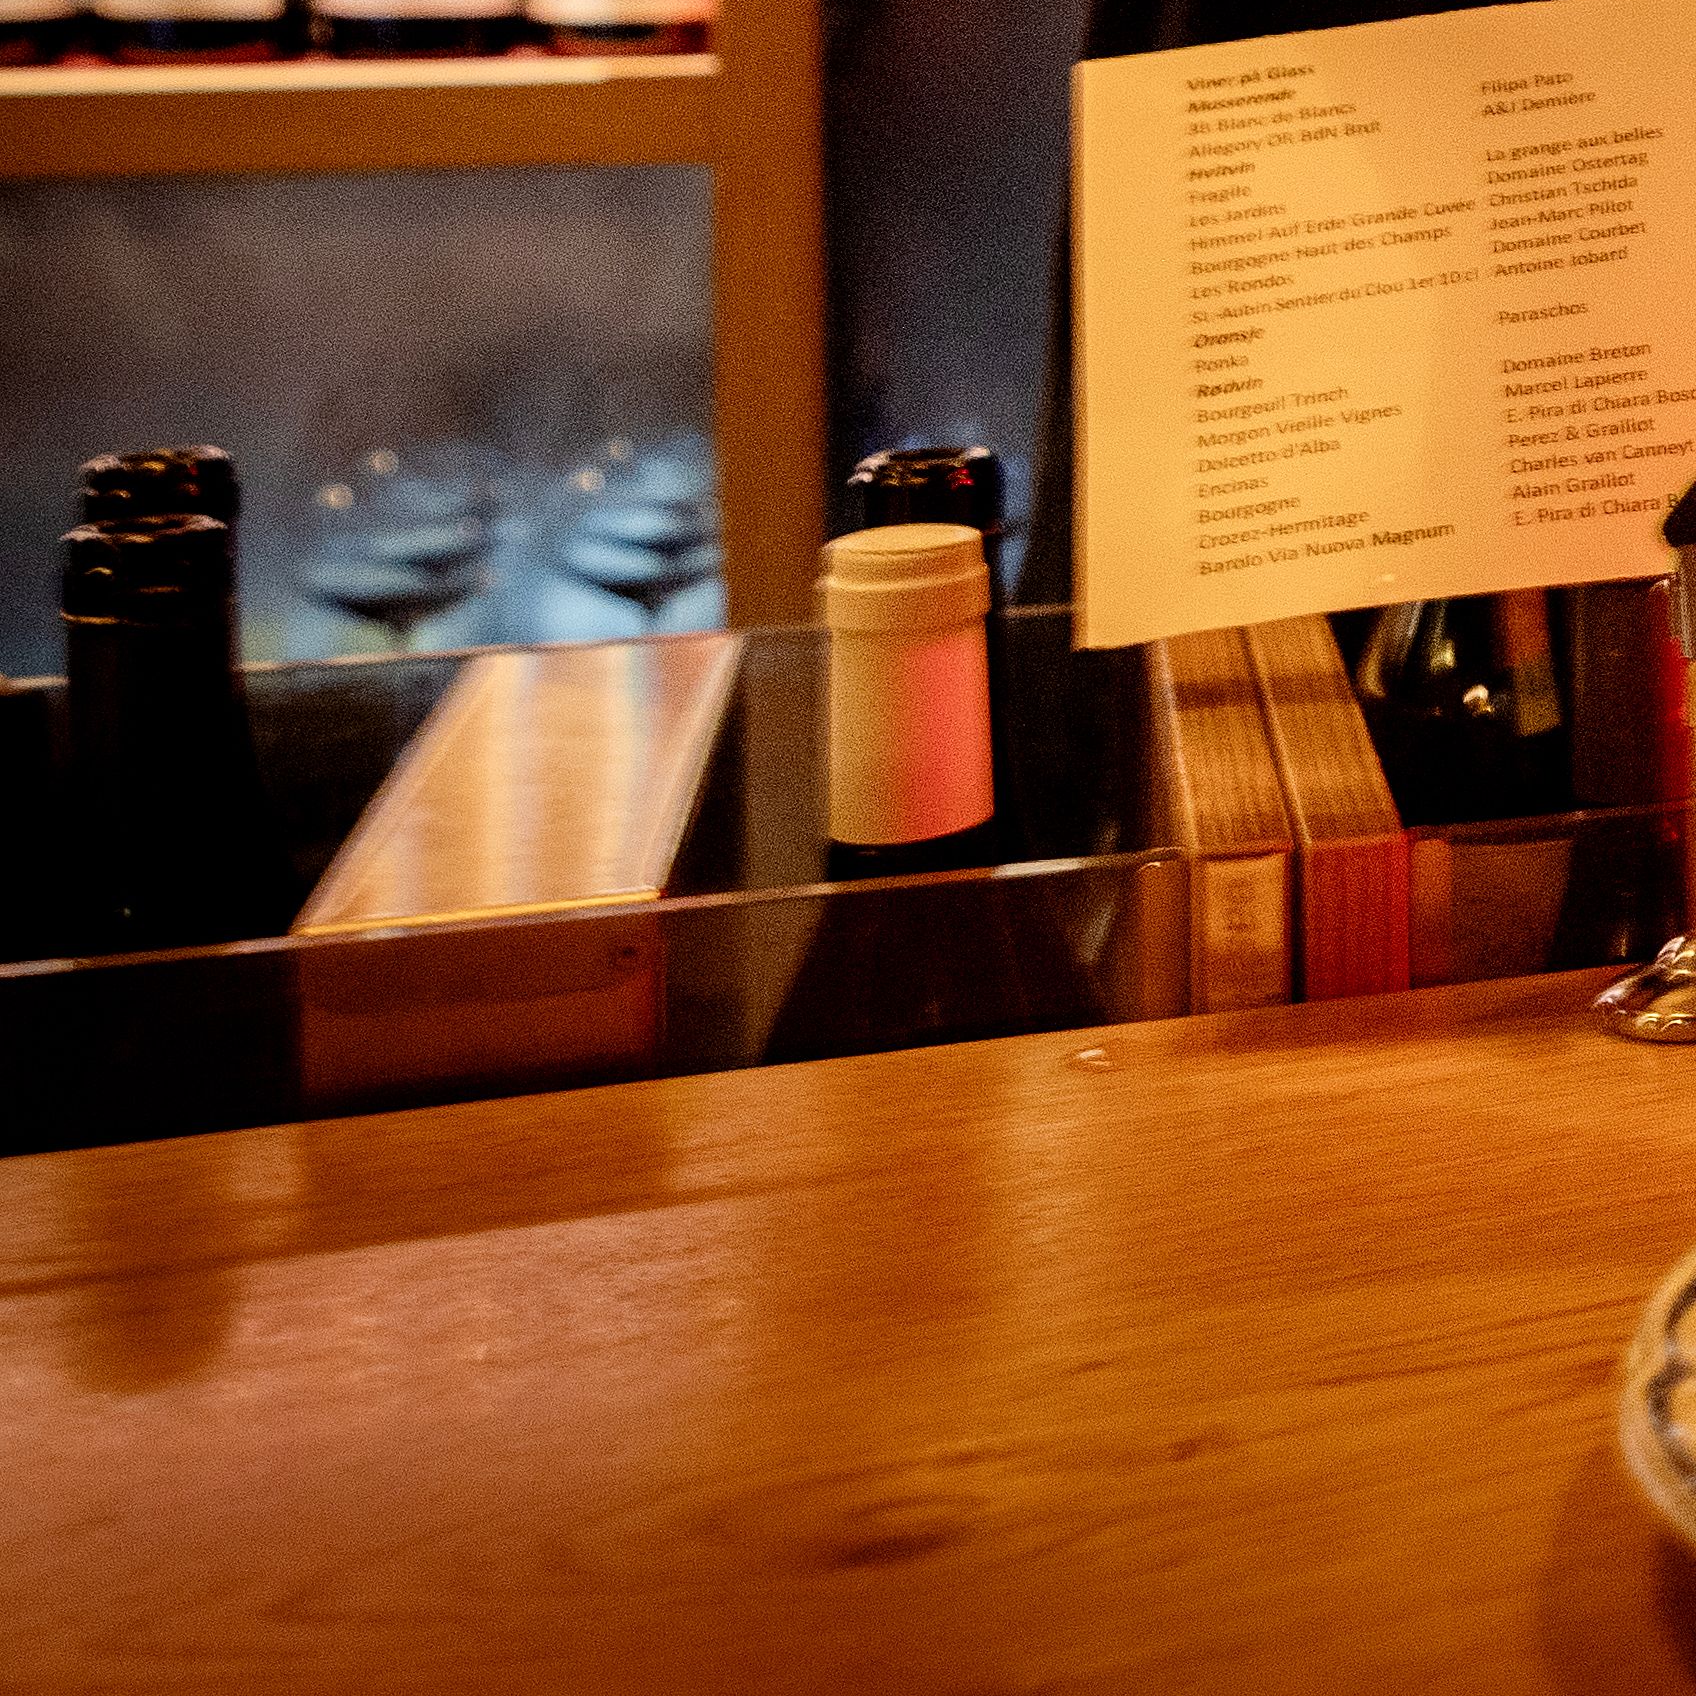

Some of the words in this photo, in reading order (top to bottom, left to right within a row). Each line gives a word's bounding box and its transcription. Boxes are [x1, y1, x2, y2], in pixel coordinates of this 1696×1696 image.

[1185, 75, 1235, 92] Viner
[1237, 68, 1262, 87] på
[1265, 64, 1314, 81] Glass
[1186, 88, 1294, 114] Musserende
[1217, 116, 1262, 132] Blanc
[1271, 111, 1293, 125] de
[1298, 103, 1356, 120] Blancs
[1479, 77, 1529, 96] Filipa
[1532, 71, 1573, 88] Pato
[1188, 139, 1260, 158] Allegory
[1188, 185, 1248, 204] Fragile
[1484, 148, 1507, 164] La
[1509, 139, 1572, 162] grange
[1575, 134, 1607, 151] aux
[1611, 125, 1663, 145] belles
[1188, 214, 1218, 229] Les
[1225, 203, 1285, 222] Jardins
[1486, 163, 1566, 185] Domaine
[1571, 151, 1648, 173] Ostertag
[1189, 230, 1262, 252] Himmel
[1268, 221, 1299, 239] Auf
[1305, 217, 1346, 235] Erde
[1351, 206, 1417, 228] Grande
[1488, 186, 1567, 208] Christian
[1573, 174, 1638, 195] Tschida
[1189, 250, 1289, 276] Bourgogne
[1294, 241, 1337, 259] Haut
[1342, 237, 1373, 253] des
[1380, 225, 1450, 247] Champs
[1489, 207, 1582, 231] Jean-Marc
[1190, 285, 1221, 301] Les
[1491, 232, 1572, 255] Domaine
[1578, 220, 1646, 242] Courbet
[1493, 256, 1564, 278] Antoine
[1496, 301, 1588, 325] Paraschos
[1191, 326, 1264, 350] Oransje
[1500, 351, 1585, 375] Domaine
[1587, 342, 1651, 363] Breton
[1193, 376, 1263, 399] Rødvin
[1196, 426, 1269, 448] Morgon
[1276, 414, 1333, 435] Vieille
[1340, 405, 1401, 425] Vignes
[1502, 376, 1567, 399] Marcel
[1573, 368, 1647, 390] Lapierre
[1197, 450, 1277, 473] Dolcetto
[1281, 439, 1340, 459] d'Alba
[1526, 404, 1564, 421] Pira
[1592, 393, 1650, 413] Chiara
[1504, 430, 1559, 449] Perez
[1585, 417, 1654, 439] Graillot
[1197, 496, 1298, 525] Bourgogne
[1508, 454, 1578, 475] Charles
[1583, 449, 1617, 465] van
[1508, 482, 1560, 501] Alain
[1565, 471, 1634, 494] Graillot
[1198, 553, 1263, 577] Barolo
[1267, 547, 1299, 564] Via
[1304, 537, 1365, 557] Nuova
[1369, 522, 1455, 547] Magnum
[1535, 506, 1574, 524] Pira
[1600, 496, 1661, 517] Chiara
